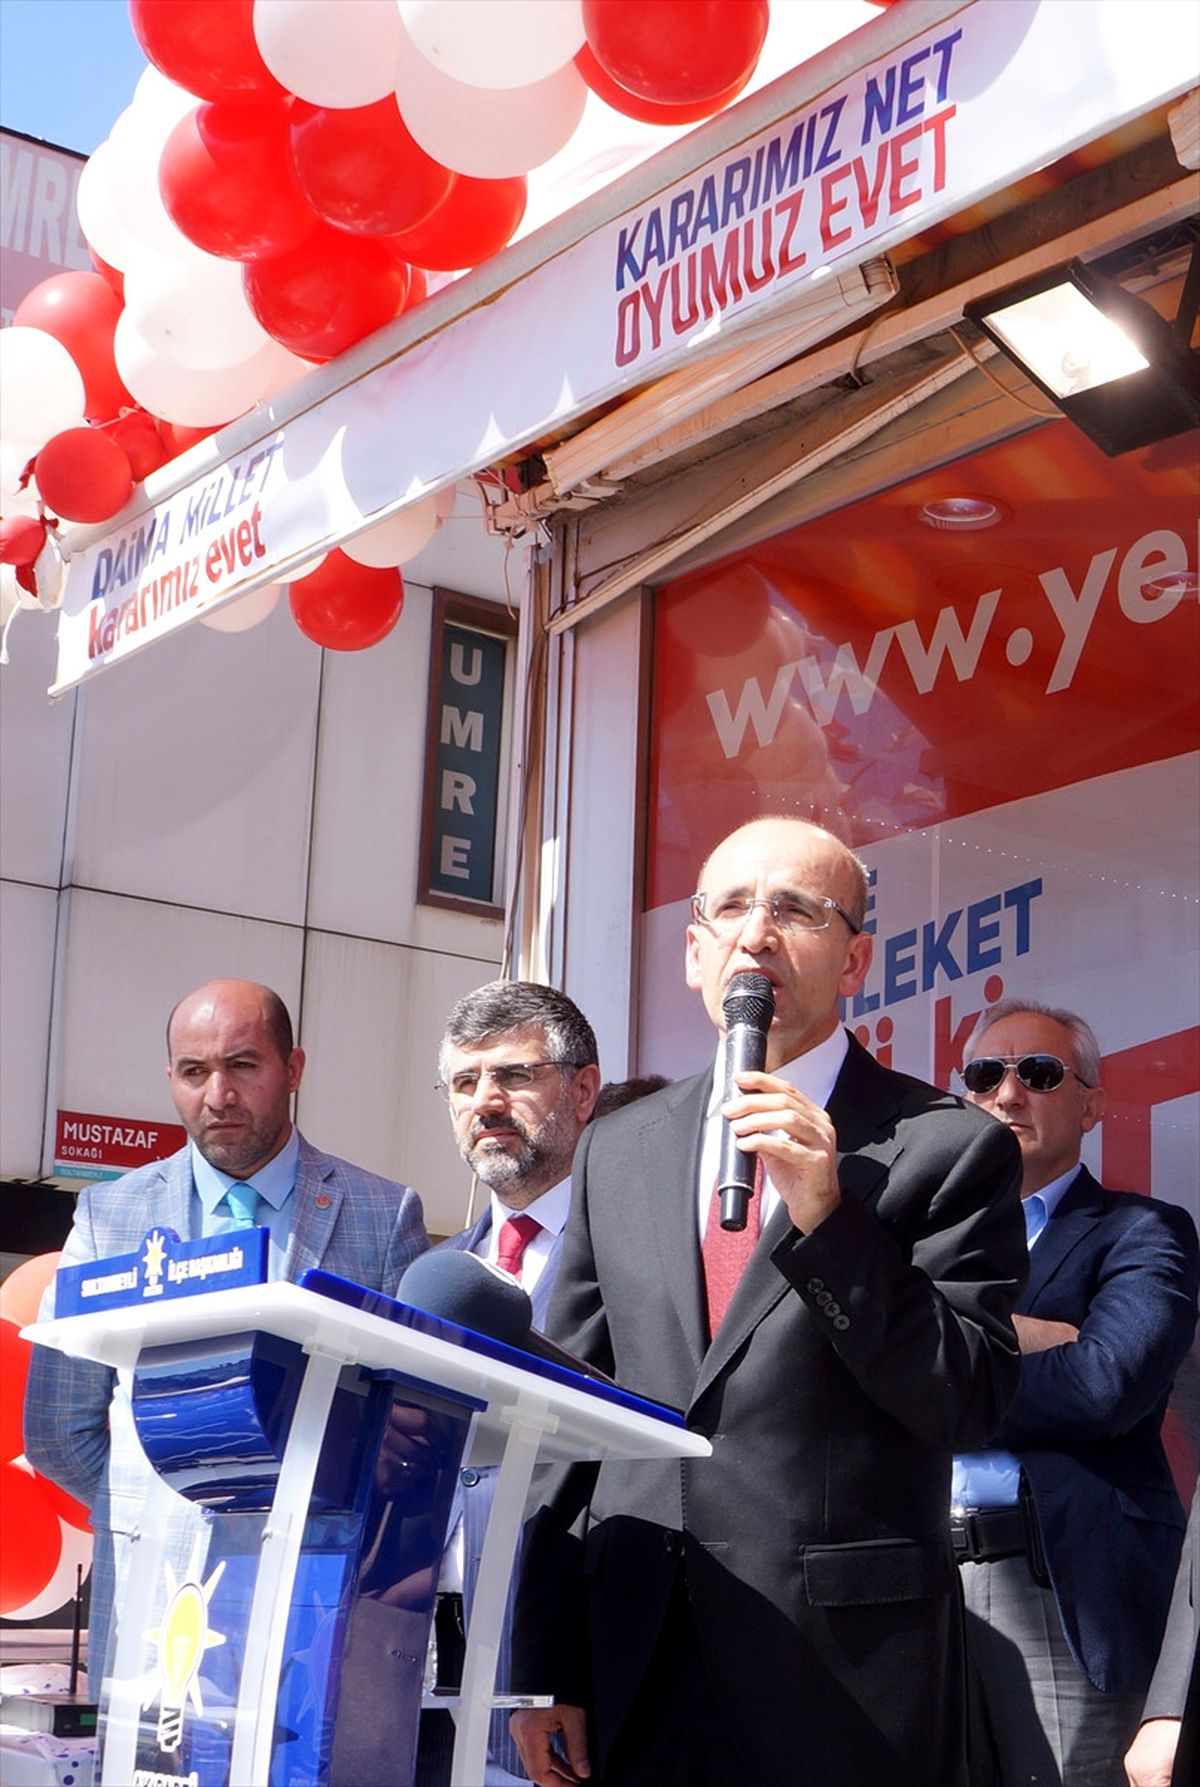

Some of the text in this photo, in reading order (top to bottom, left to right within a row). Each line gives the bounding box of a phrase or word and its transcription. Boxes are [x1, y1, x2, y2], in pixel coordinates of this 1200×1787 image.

[615, 104, 957, 367] OYUMUZ EVET
[616, 28, 963, 291] KARARIMIZ NET
[88, 501, 266, 660] kararımız evet
[705, 518, 1200, 759] www.ye
[440, 642, 485, 880] UMRE
[61, 1145, 103, 1159] SOKAĞI
[63, 1121, 159, 1149] MUSTAZAF
